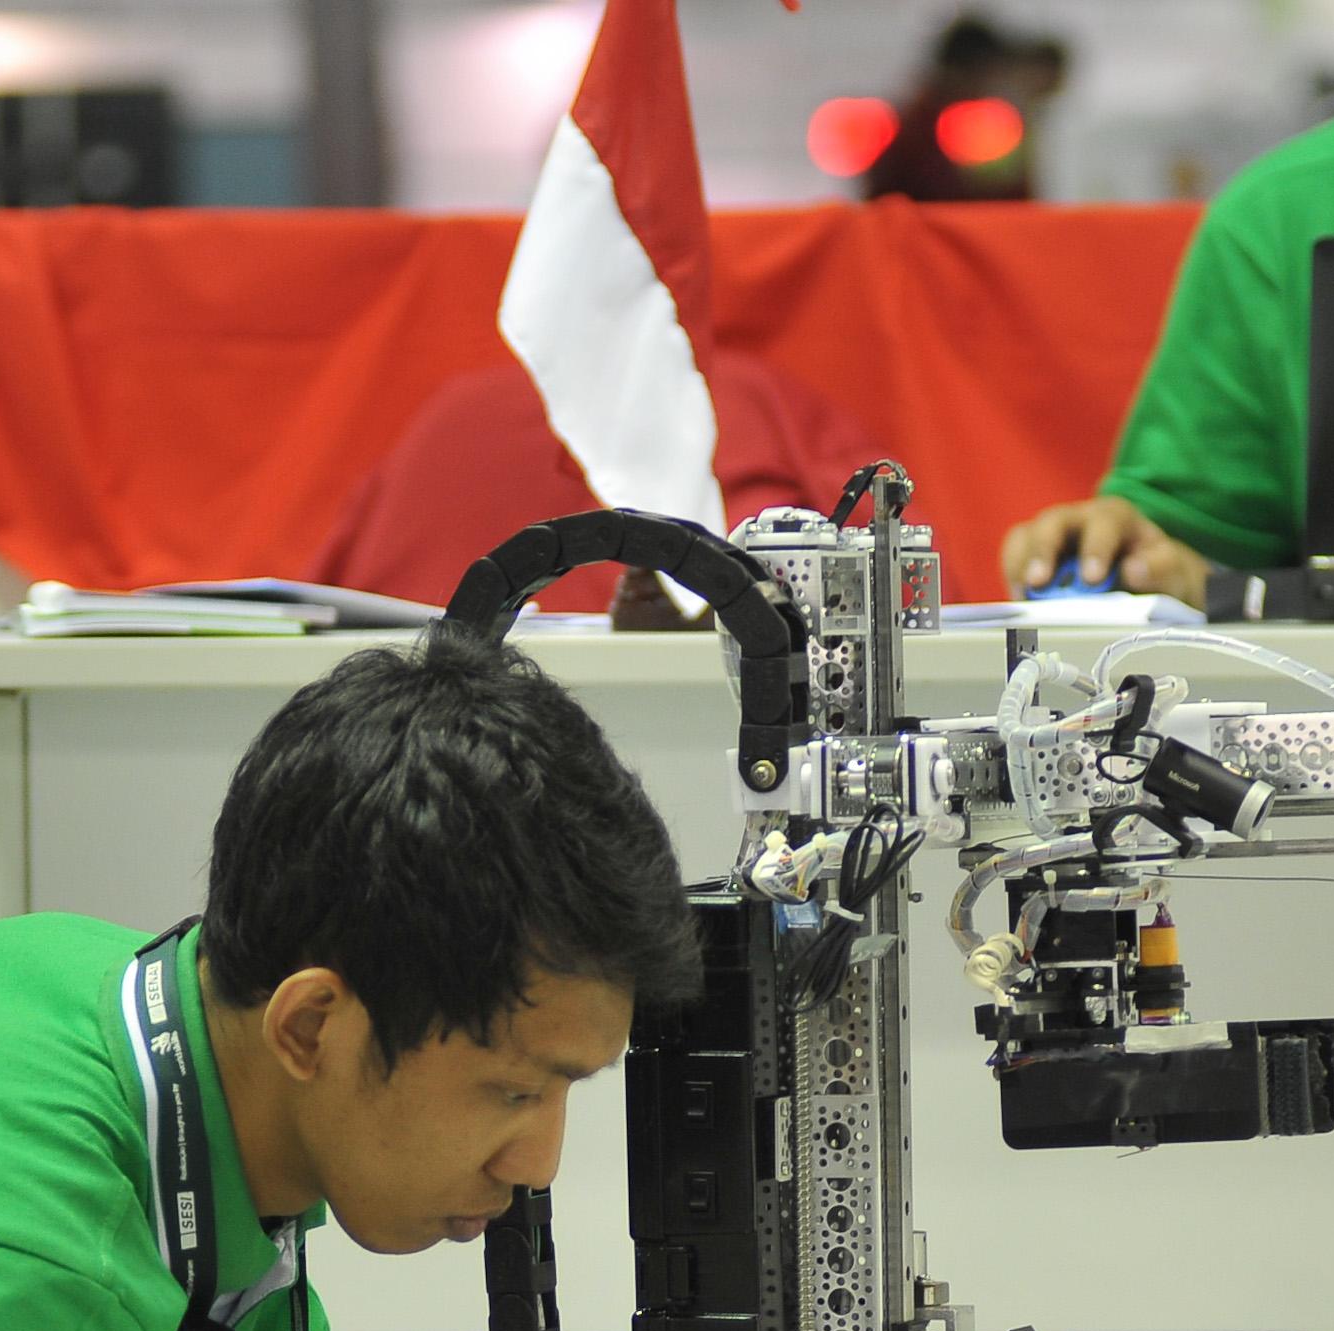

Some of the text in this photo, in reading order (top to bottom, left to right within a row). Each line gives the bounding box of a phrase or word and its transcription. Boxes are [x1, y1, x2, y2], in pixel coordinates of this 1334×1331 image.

[1168, 769, 1201, 792] Microsoft
[148, 964, 161, 1001] SENAI
[180, 1196, 194, 1229] SESI
